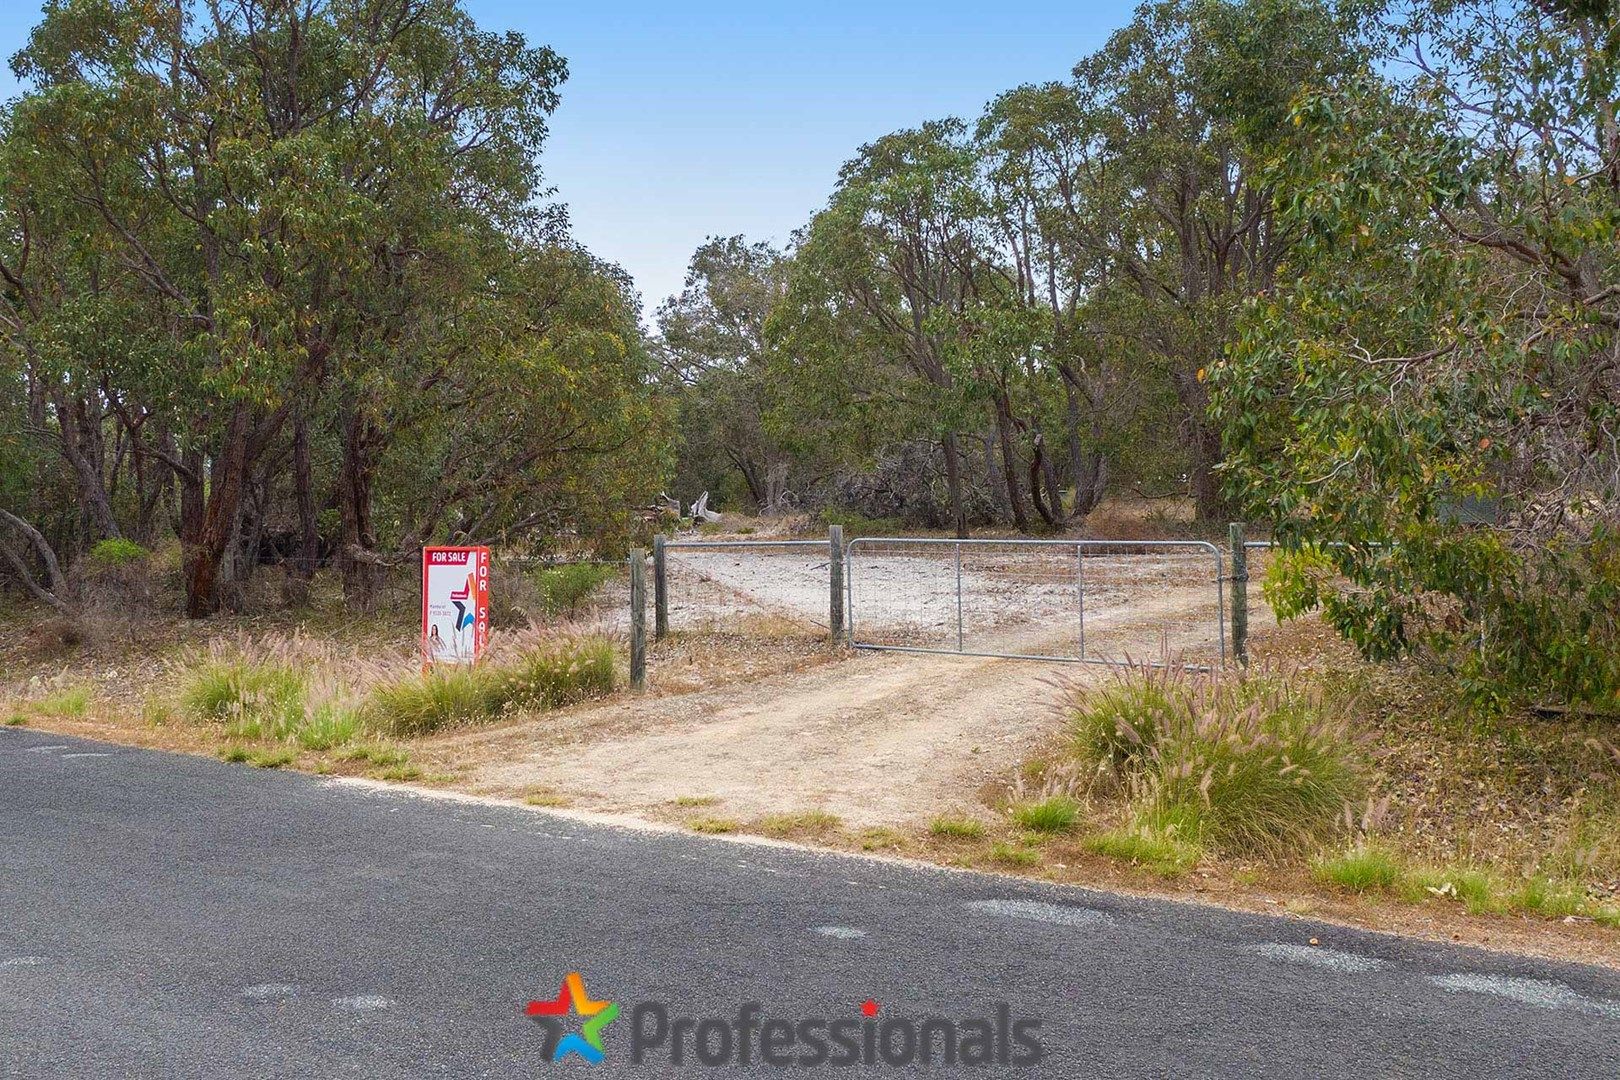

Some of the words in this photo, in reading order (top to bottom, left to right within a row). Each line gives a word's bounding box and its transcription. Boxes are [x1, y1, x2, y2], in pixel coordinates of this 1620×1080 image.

[432, 552, 447, 562] FOR
[447, 552, 466, 562] SALE
[479, 552, 488, 591] FOR
[478, 607, 487, 648] SAL
